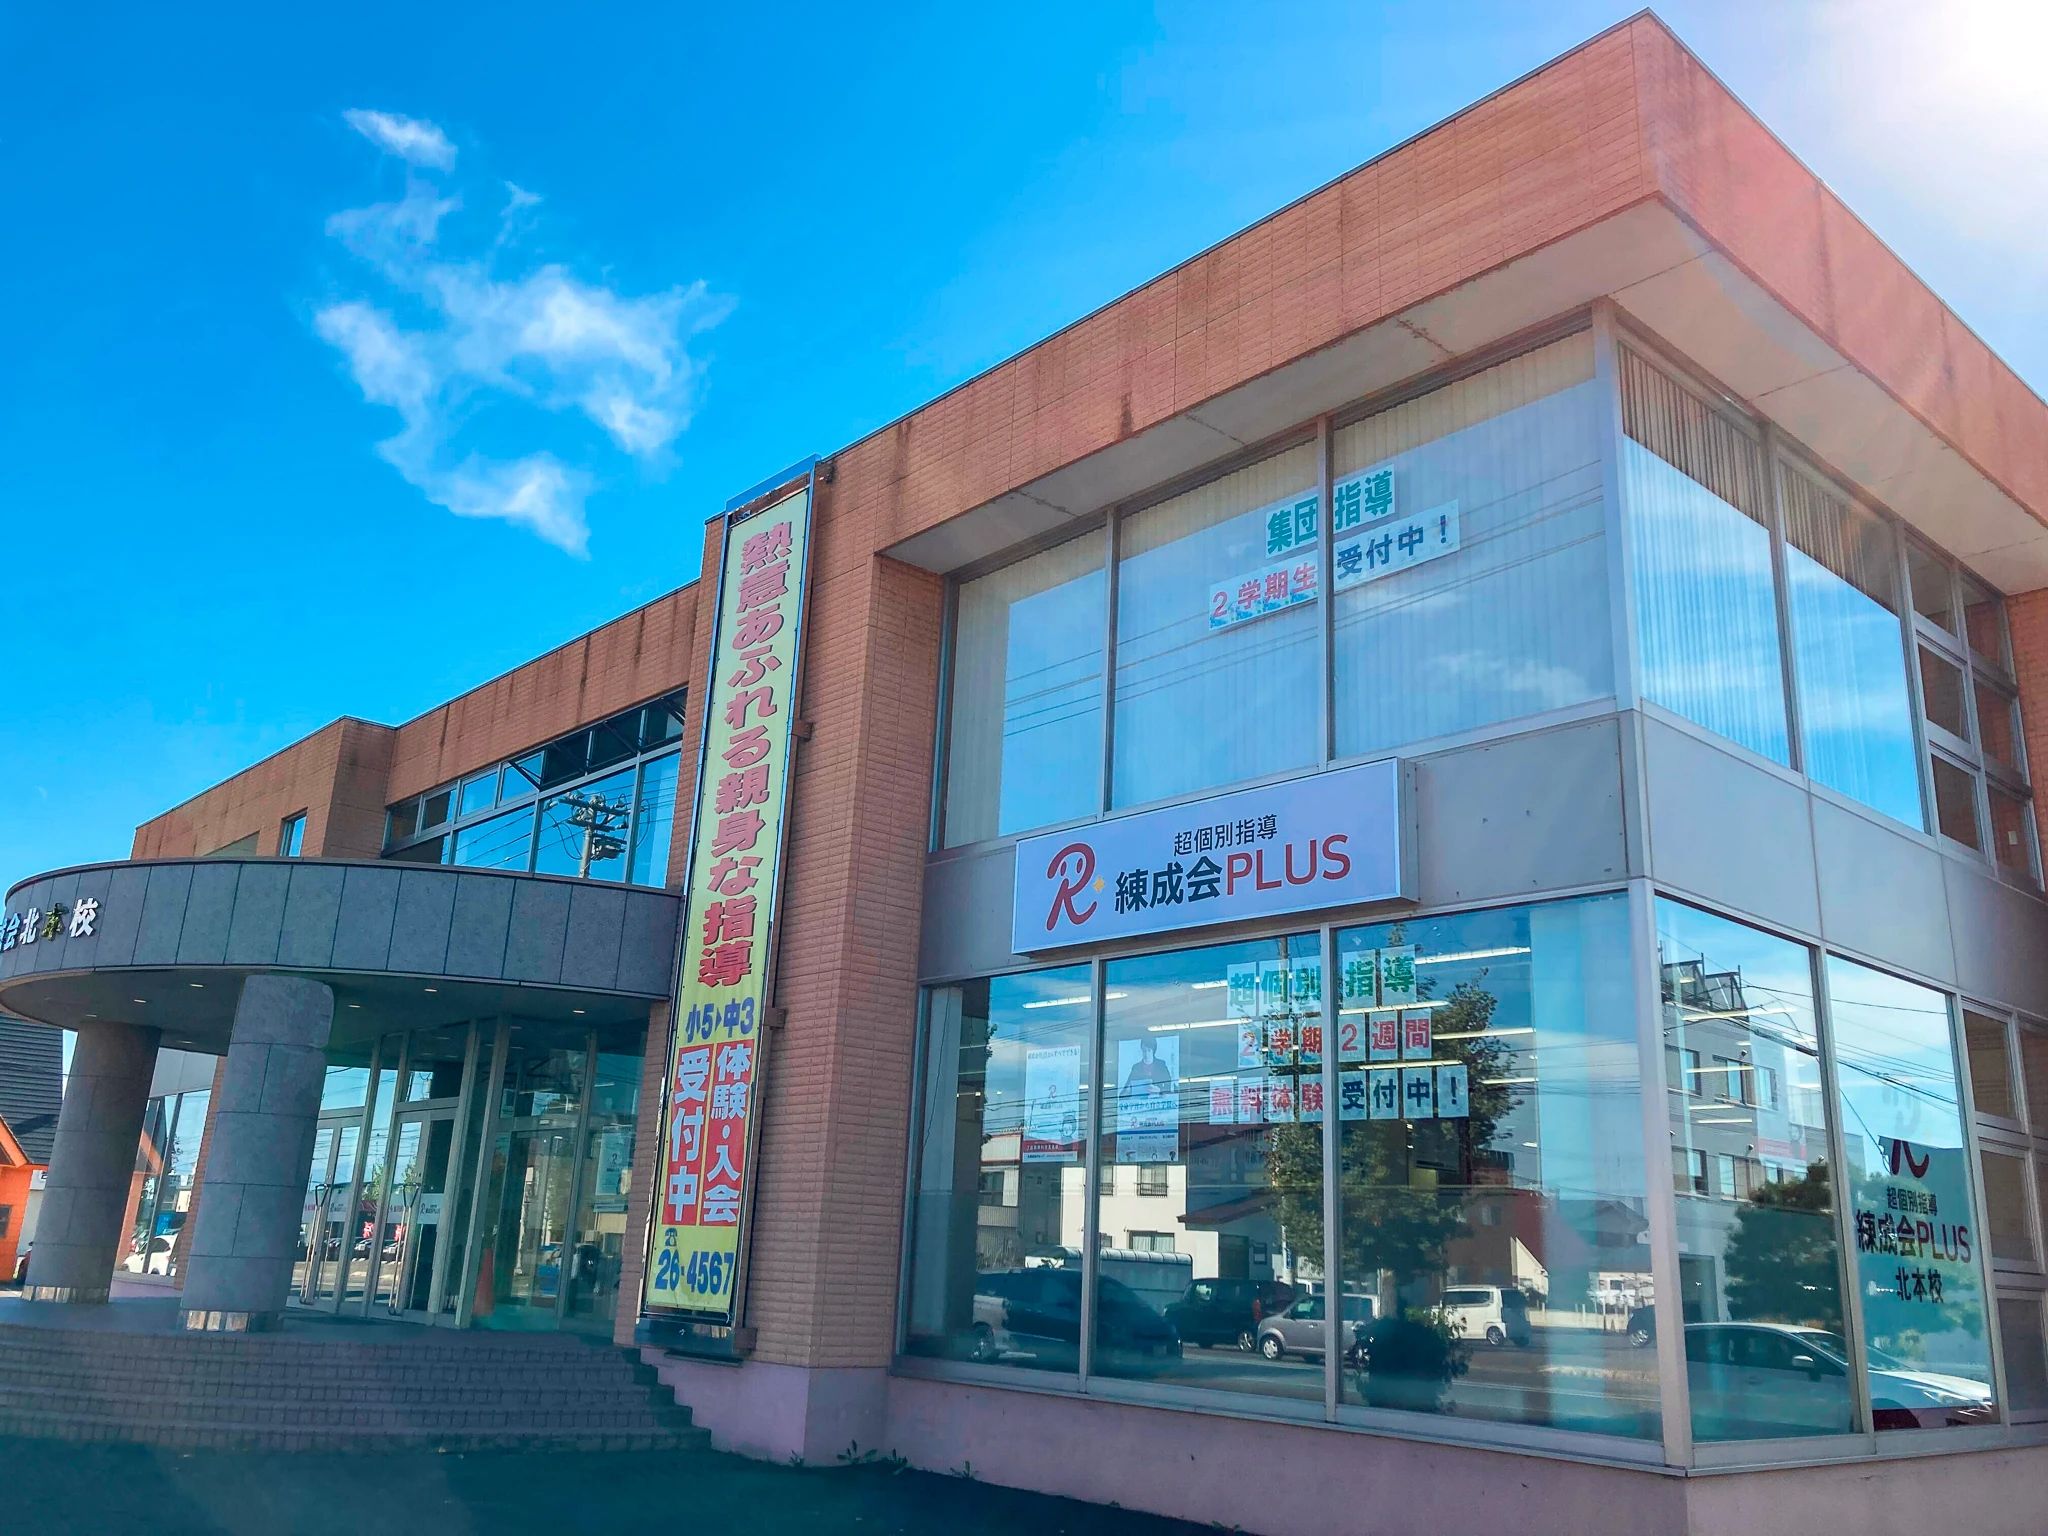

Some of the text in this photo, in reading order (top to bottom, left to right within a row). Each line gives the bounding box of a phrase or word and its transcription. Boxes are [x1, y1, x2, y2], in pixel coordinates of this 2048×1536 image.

[698, 521, 793, 988] 熱意あふれる親身な指導
[1173, 814, 1278, 857] 超個別指導
[0, 898, 98, 951] 会北本校
[667, 1047, 710, 1221] 受付中
[1886, 1186, 1938, 1216] 超個別指導
[654, 1249, 735, 1296] 26-4567
[1896, 1266, 1944, 1303] 北本校
